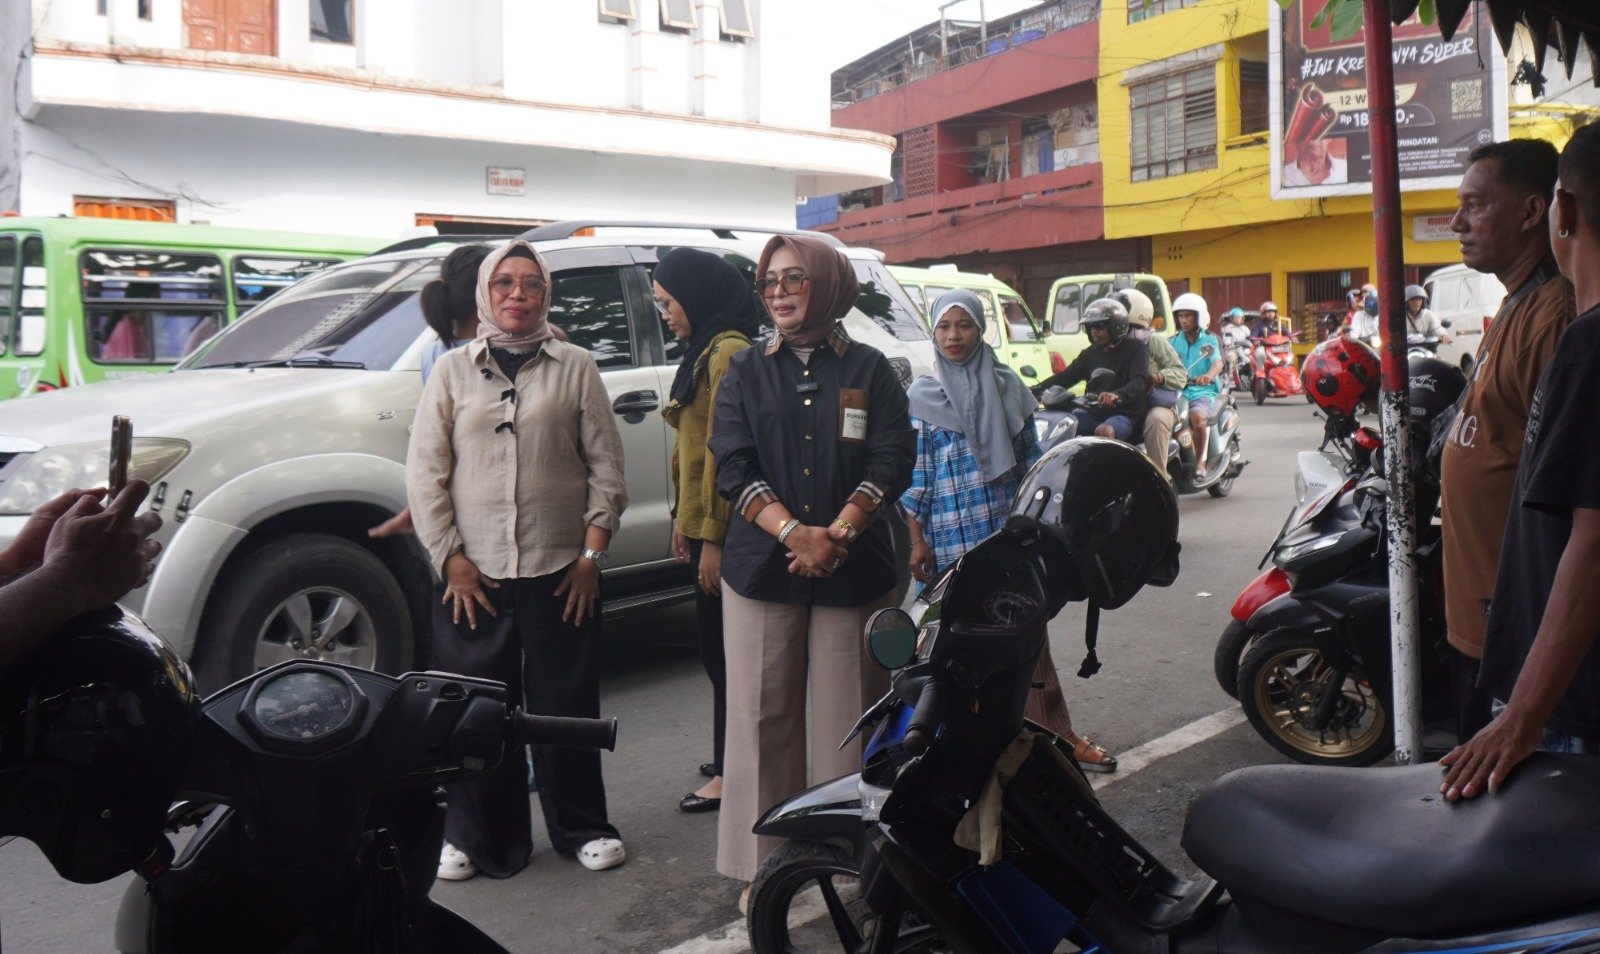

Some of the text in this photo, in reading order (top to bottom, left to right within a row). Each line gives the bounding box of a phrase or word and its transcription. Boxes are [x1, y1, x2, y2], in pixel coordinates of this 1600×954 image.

[1301, 57, 1333, 79] #INI
[1420, 37, 1476, 64] SUPER
[1340, 95, 1351, 106] 12
[1340, 114, 1352, 125] Rp
